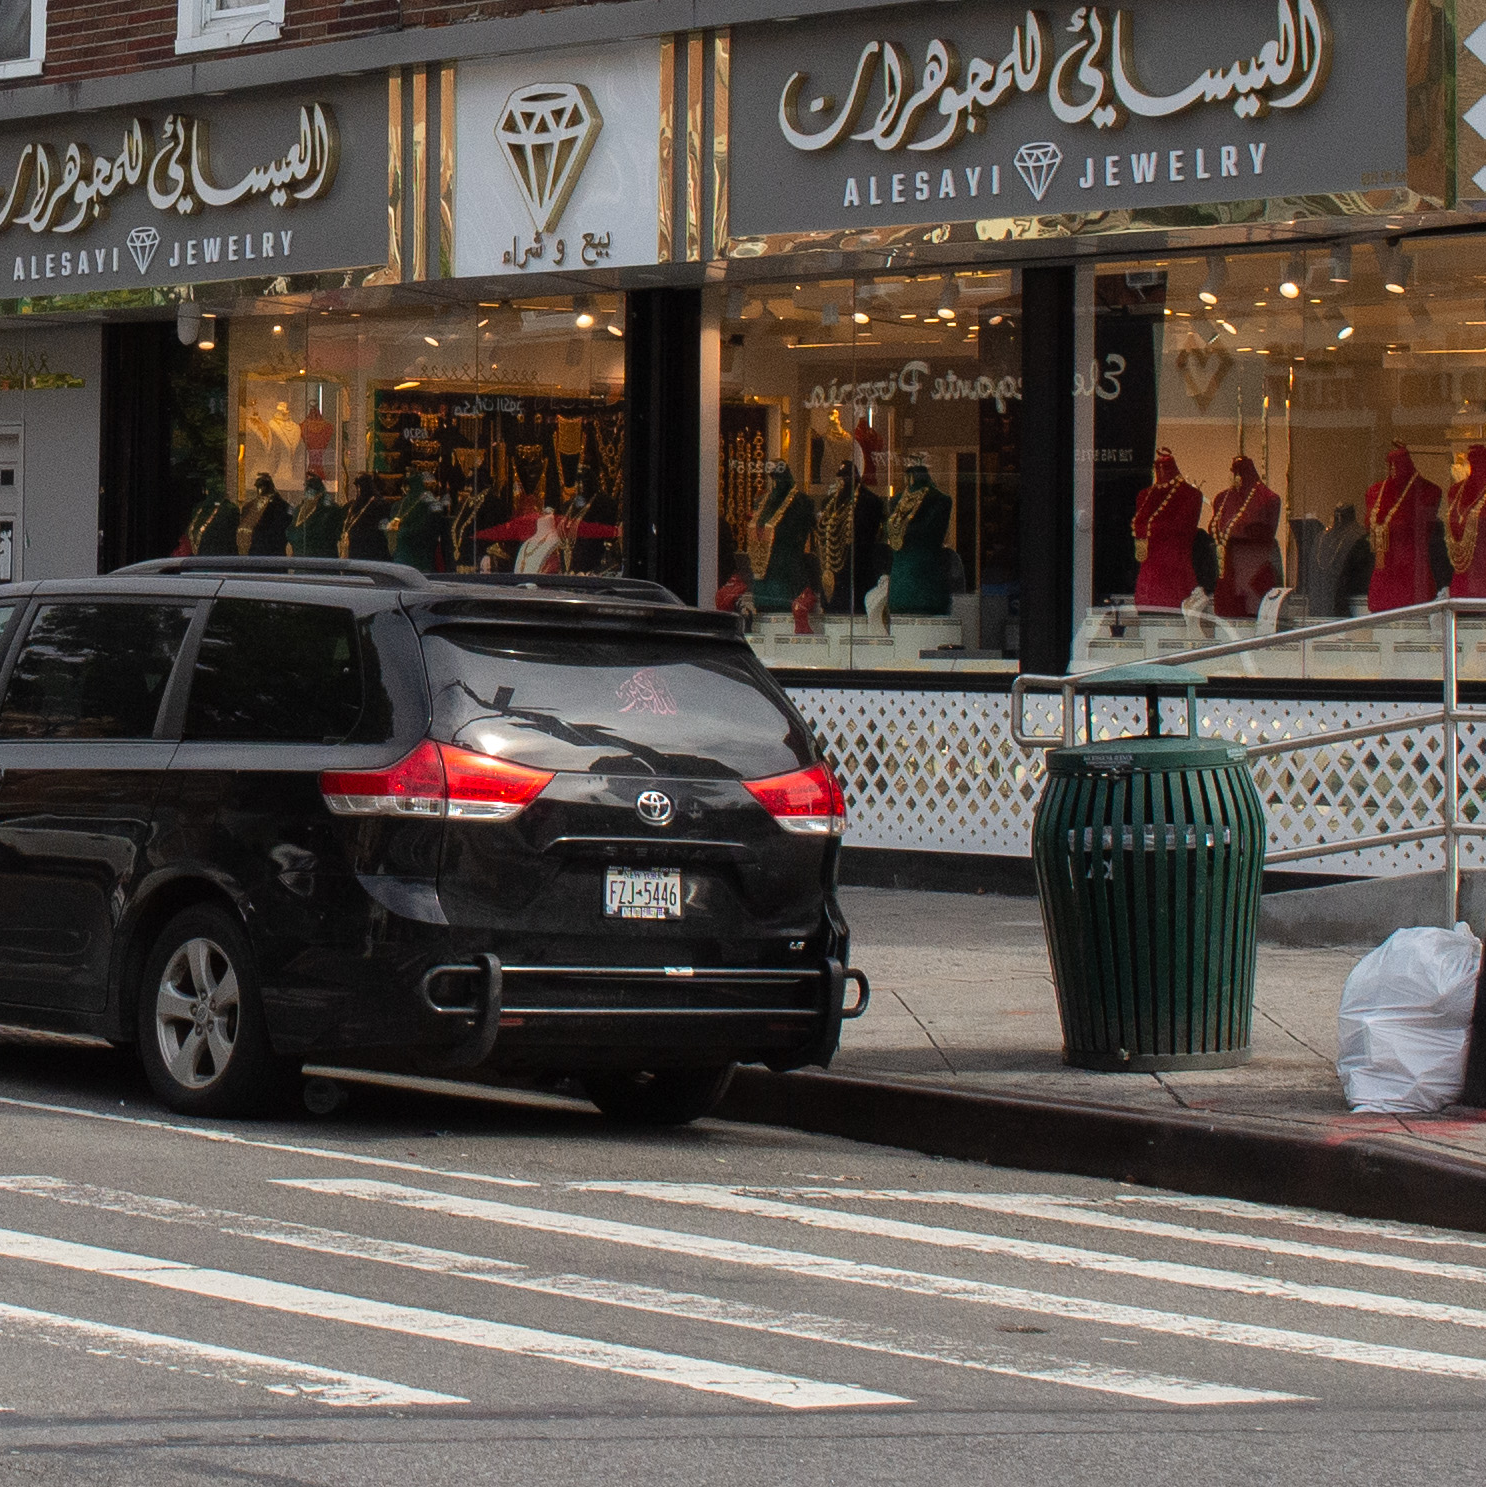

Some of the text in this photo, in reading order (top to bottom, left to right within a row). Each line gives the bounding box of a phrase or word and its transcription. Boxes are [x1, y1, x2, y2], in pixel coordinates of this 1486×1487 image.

[844, 143, 1267, 207] ALESAYI JEWELRY
[14, 230, 294, 281] ALESAYI JEWELRY
